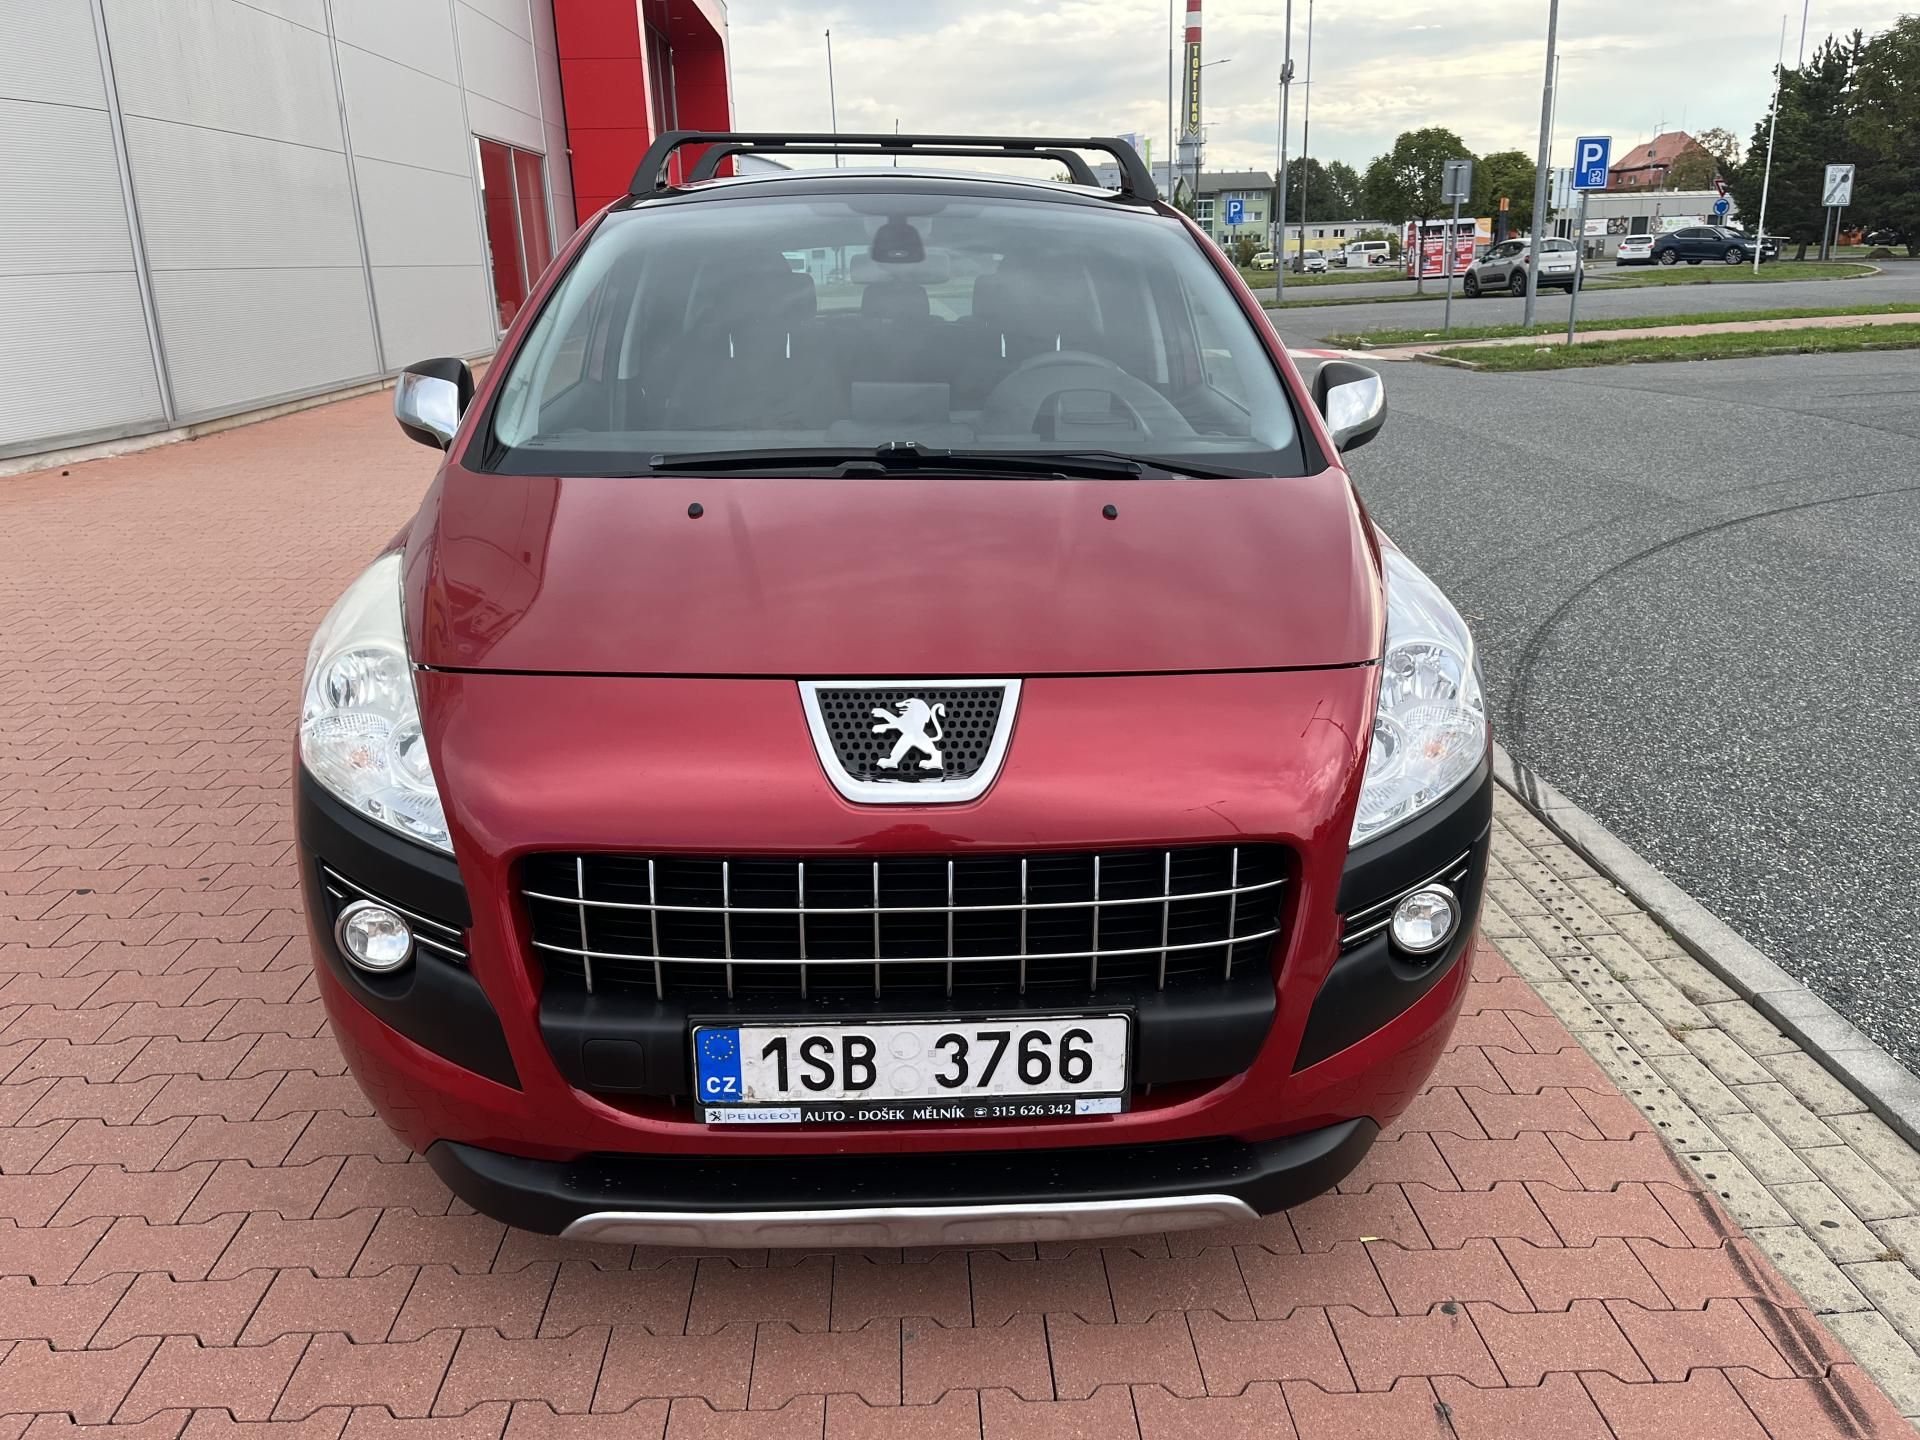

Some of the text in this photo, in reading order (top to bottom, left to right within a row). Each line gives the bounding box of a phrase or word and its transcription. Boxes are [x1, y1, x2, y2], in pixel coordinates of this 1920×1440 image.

[1191, 45, 1199, 122] TOFITKO
[1581, 143, 1603, 174] P
[1230, 202, 1241, 217] P
[761, 1028, 1094, 1092] 1SB 3766
[706, 1076, 737, 1094] CZ
[726, 1111, 800, 1121] PEUGEOT
[804, 1110, 846, 1122] AUTO
[858, 1107, 905, 1121] DOŠEK
[912, 1105, 965, 1120] MĚLNÍK
[992, 1106, 1016, 1117] 315
[1020, 1105, 1044, 1116] 626
[1047, 1104, 1072, 1115] 342
